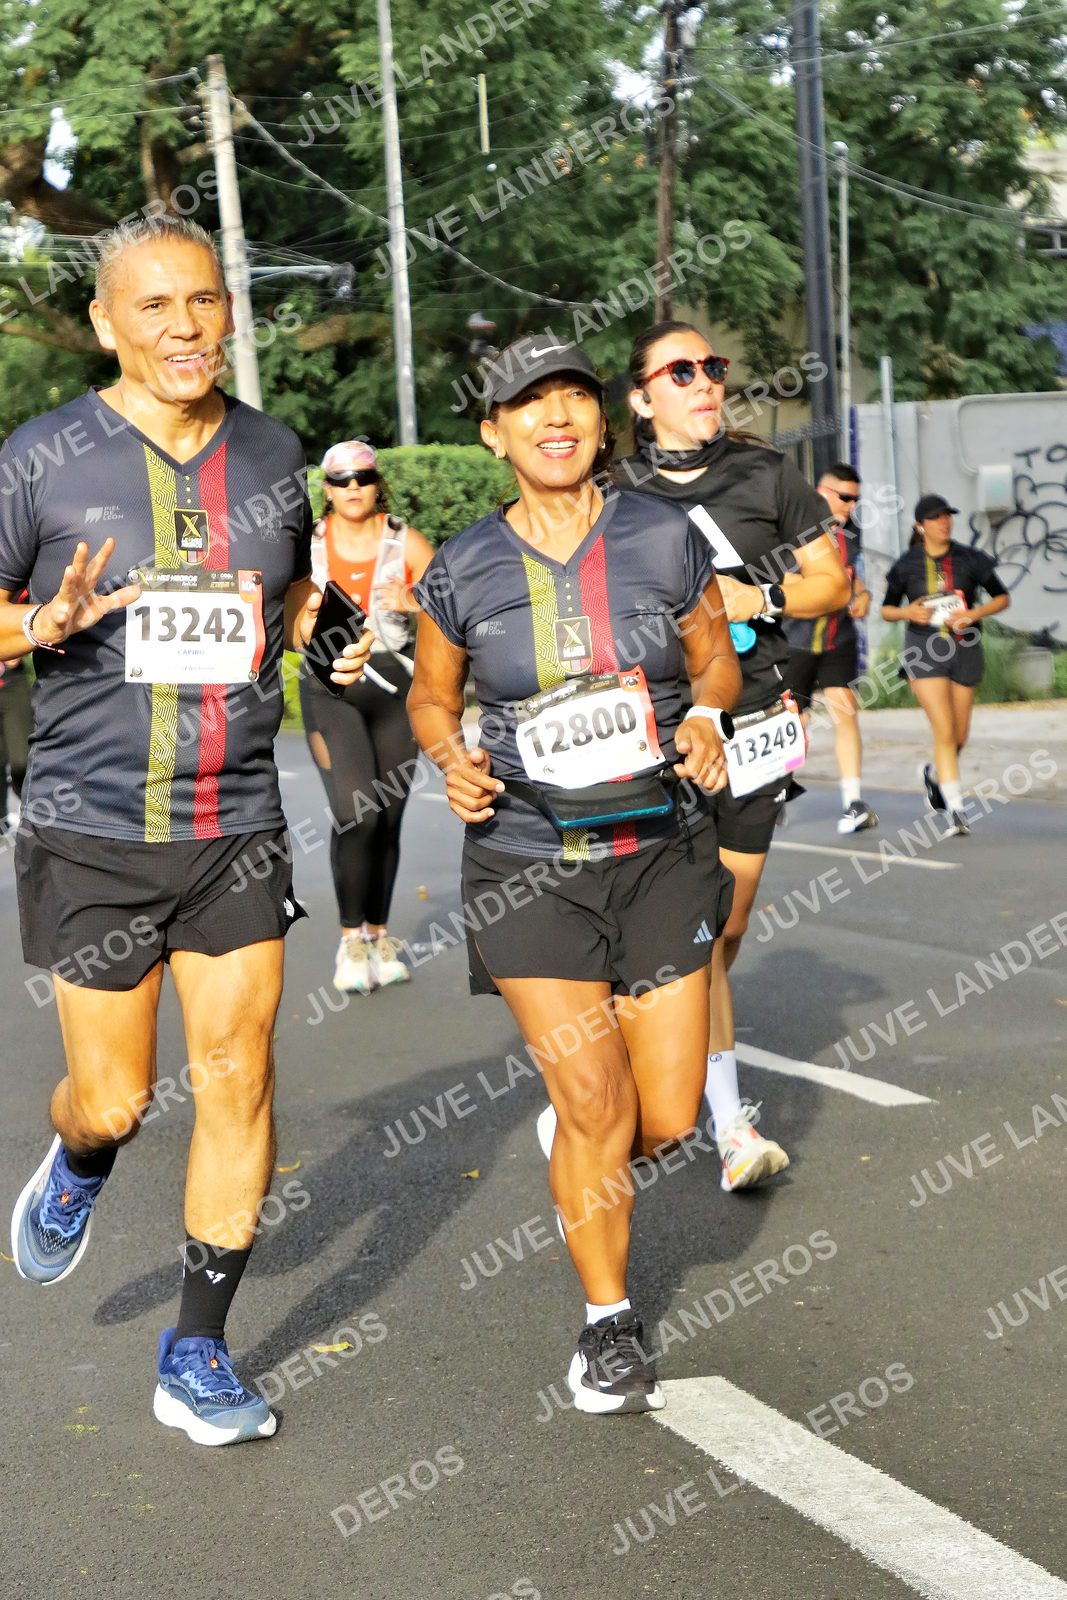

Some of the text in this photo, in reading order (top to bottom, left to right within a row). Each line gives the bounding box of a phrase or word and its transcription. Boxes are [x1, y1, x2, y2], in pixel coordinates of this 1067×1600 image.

[134, 606, 246, 642] 13242
[524, 702, 637, 758] 12800
[730, 720, 798, 766] 13249
